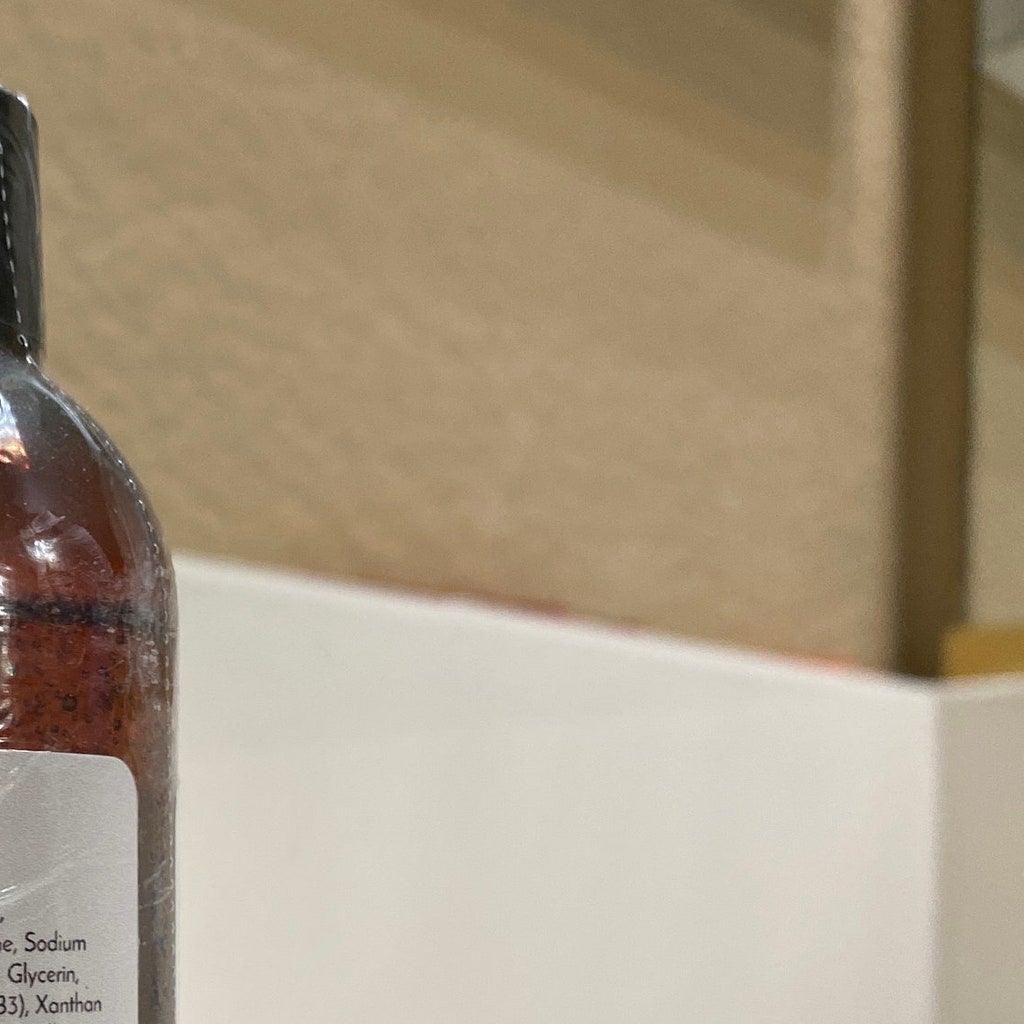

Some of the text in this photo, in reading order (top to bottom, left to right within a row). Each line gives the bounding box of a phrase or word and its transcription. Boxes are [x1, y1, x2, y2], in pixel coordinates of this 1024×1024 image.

[24, 931, 86, 951] Sodium
[7, 963, 79, 986] Glycerin,
[35, 992, 102, 1014] Xanthan
